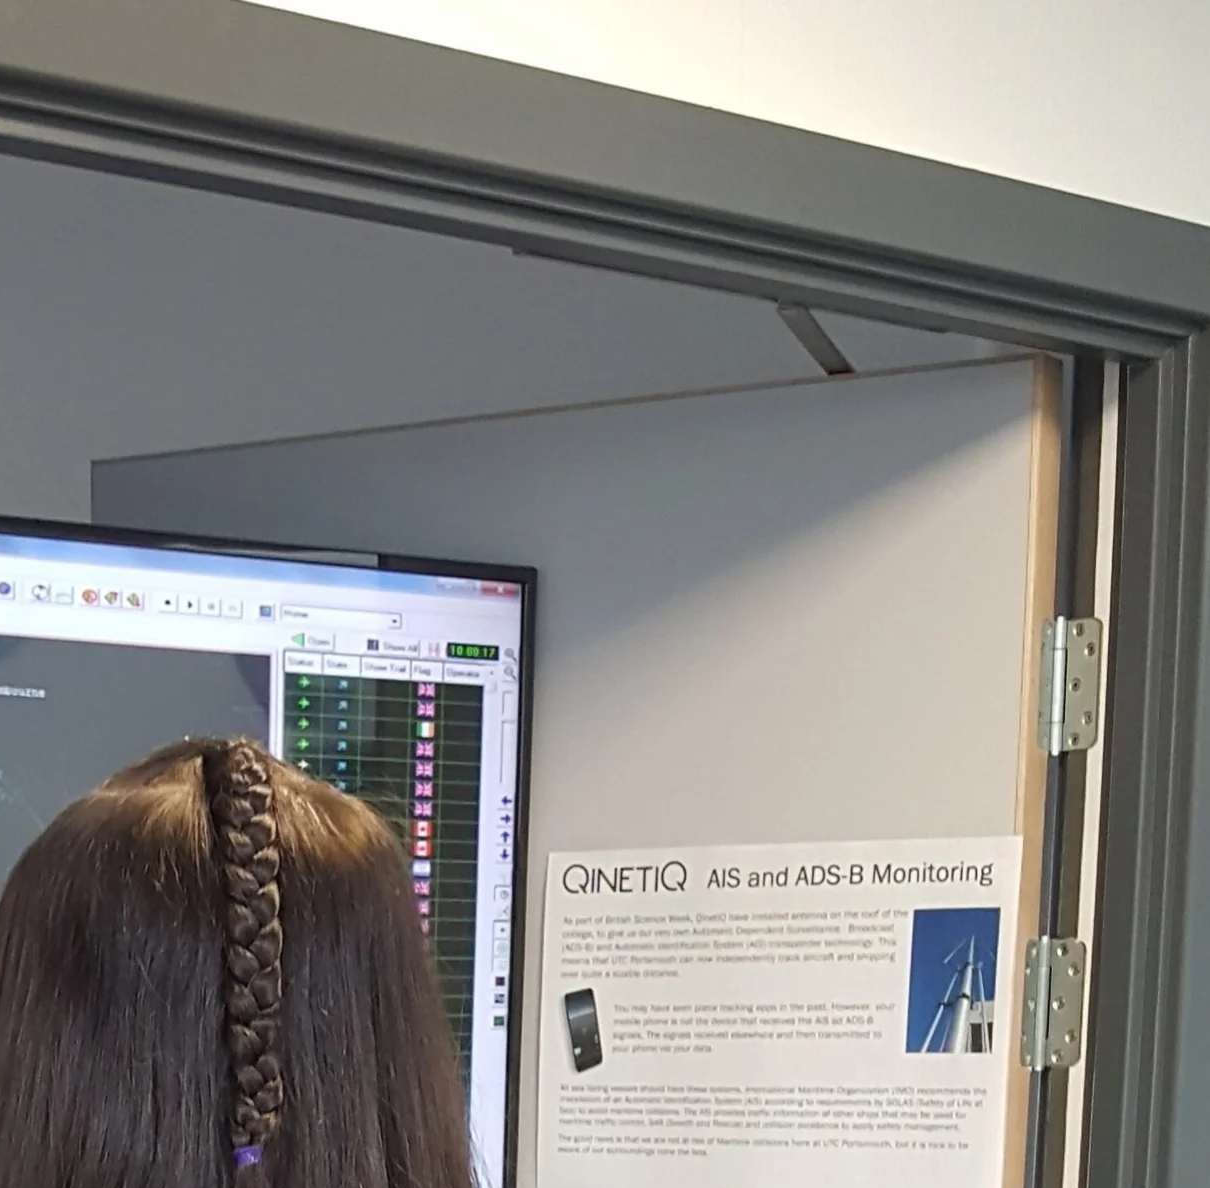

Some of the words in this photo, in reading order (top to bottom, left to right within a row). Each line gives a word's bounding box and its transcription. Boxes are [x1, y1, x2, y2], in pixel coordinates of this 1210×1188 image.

[562, 860, 687, 894] QINETIQ
[707, 867, 741, 889] AIS
[747, 866, 789, 888] and
[795, 863, 864, 887] ADS-B
[872, 860, 994, 887] Monitoring
